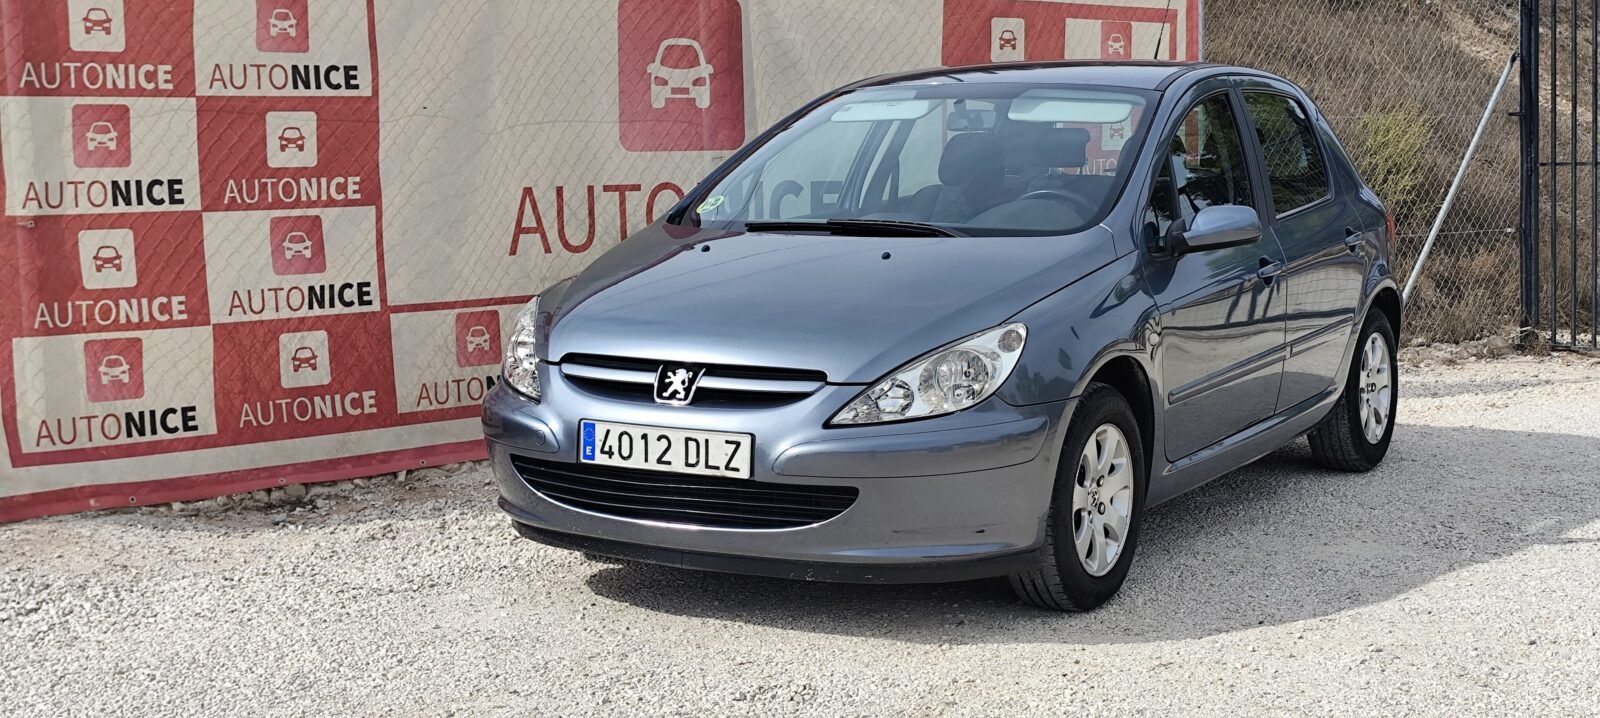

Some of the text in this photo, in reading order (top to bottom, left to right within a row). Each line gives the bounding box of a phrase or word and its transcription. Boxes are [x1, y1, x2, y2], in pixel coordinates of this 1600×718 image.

[19, 62, 174, 90] AUTONICE
[208, 63, 360, 90] AUTONICE
[22, 178, 186, 210] AUTONICE
[223, 176, 362, 205] AUTONICE
[33, 295, 189, 330] AUTONICE
[227, 281, 373, 317] AUTONICE
[238, 390, 378, 428] AUTONICE
[35, 405, 200, 448] AUTONICE
[585, 446, 593, 456] E
[599, 428, 742, 473] 4012 DLZ
